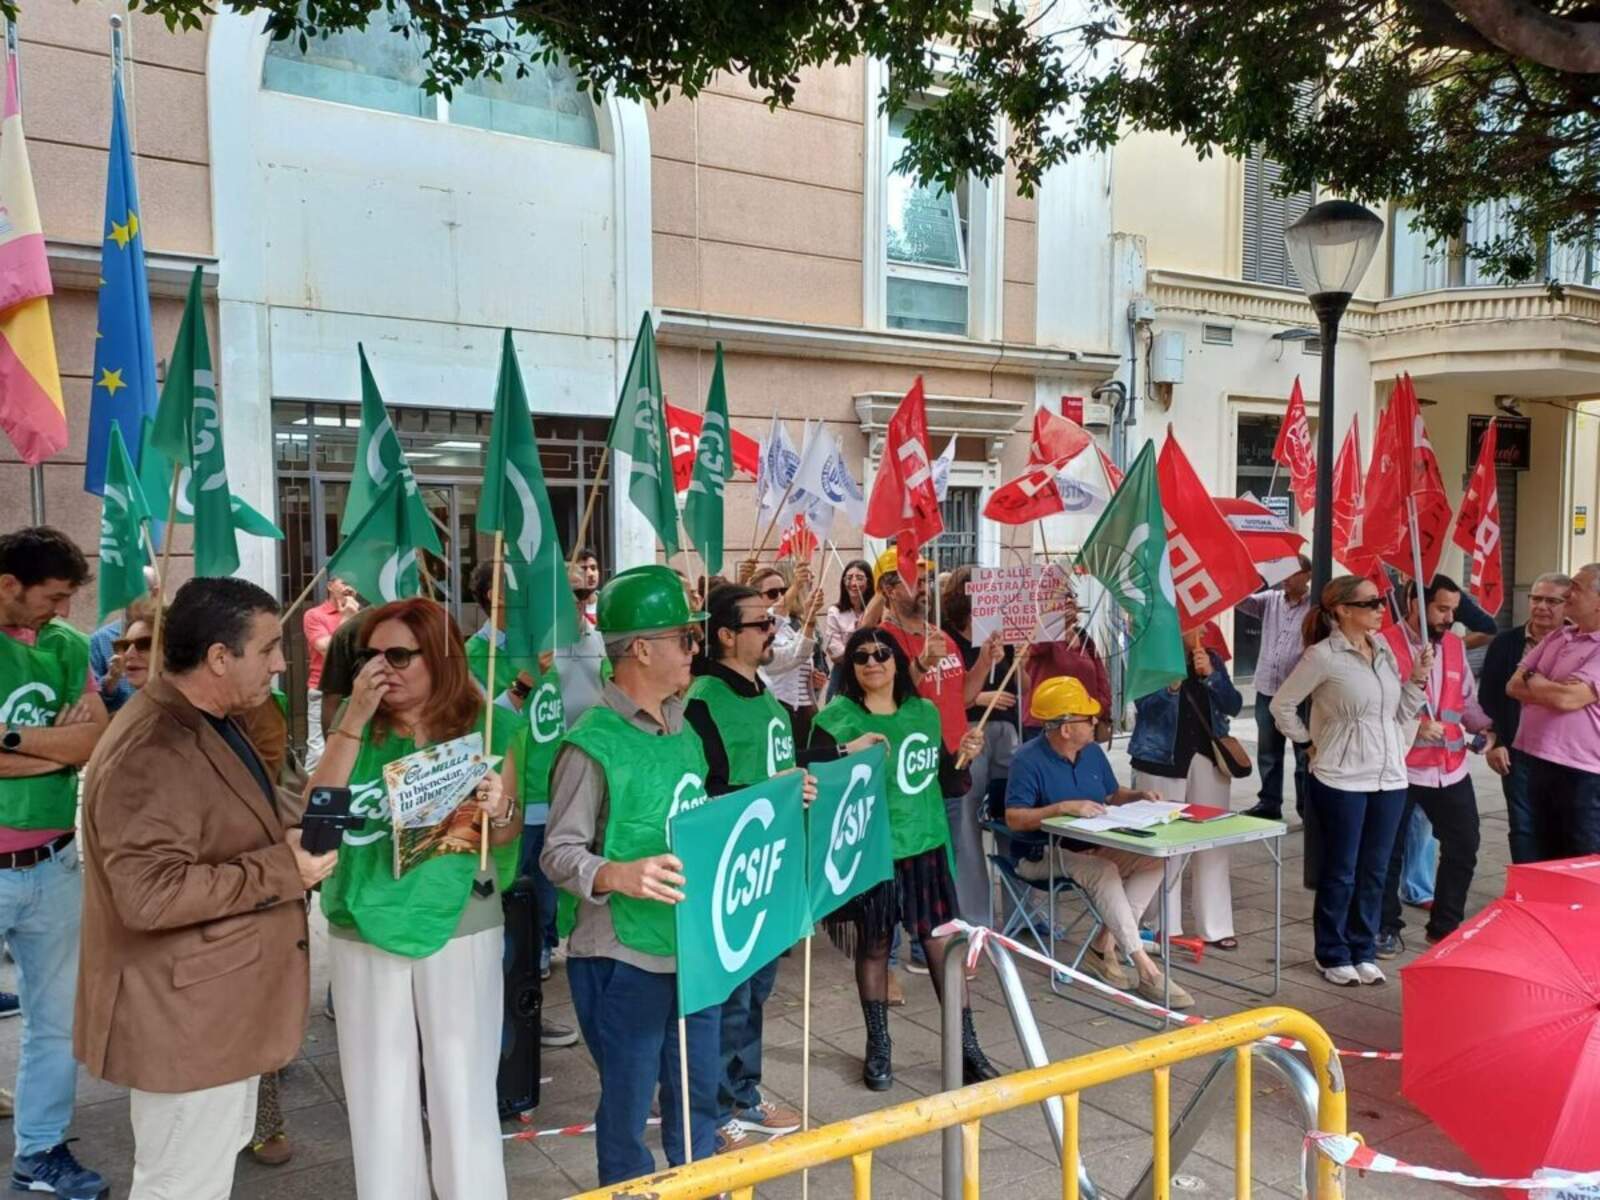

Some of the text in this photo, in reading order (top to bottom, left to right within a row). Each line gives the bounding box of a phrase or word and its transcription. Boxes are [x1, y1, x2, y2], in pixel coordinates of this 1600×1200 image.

[980, 569, 993, 580] LA
[1002, 614, 1037, 626] RUINA
[906, 746, 939, 775] CSIF
[833, 795, 876, 850] CSIF
[726, 837, 787, 916] CSIF
